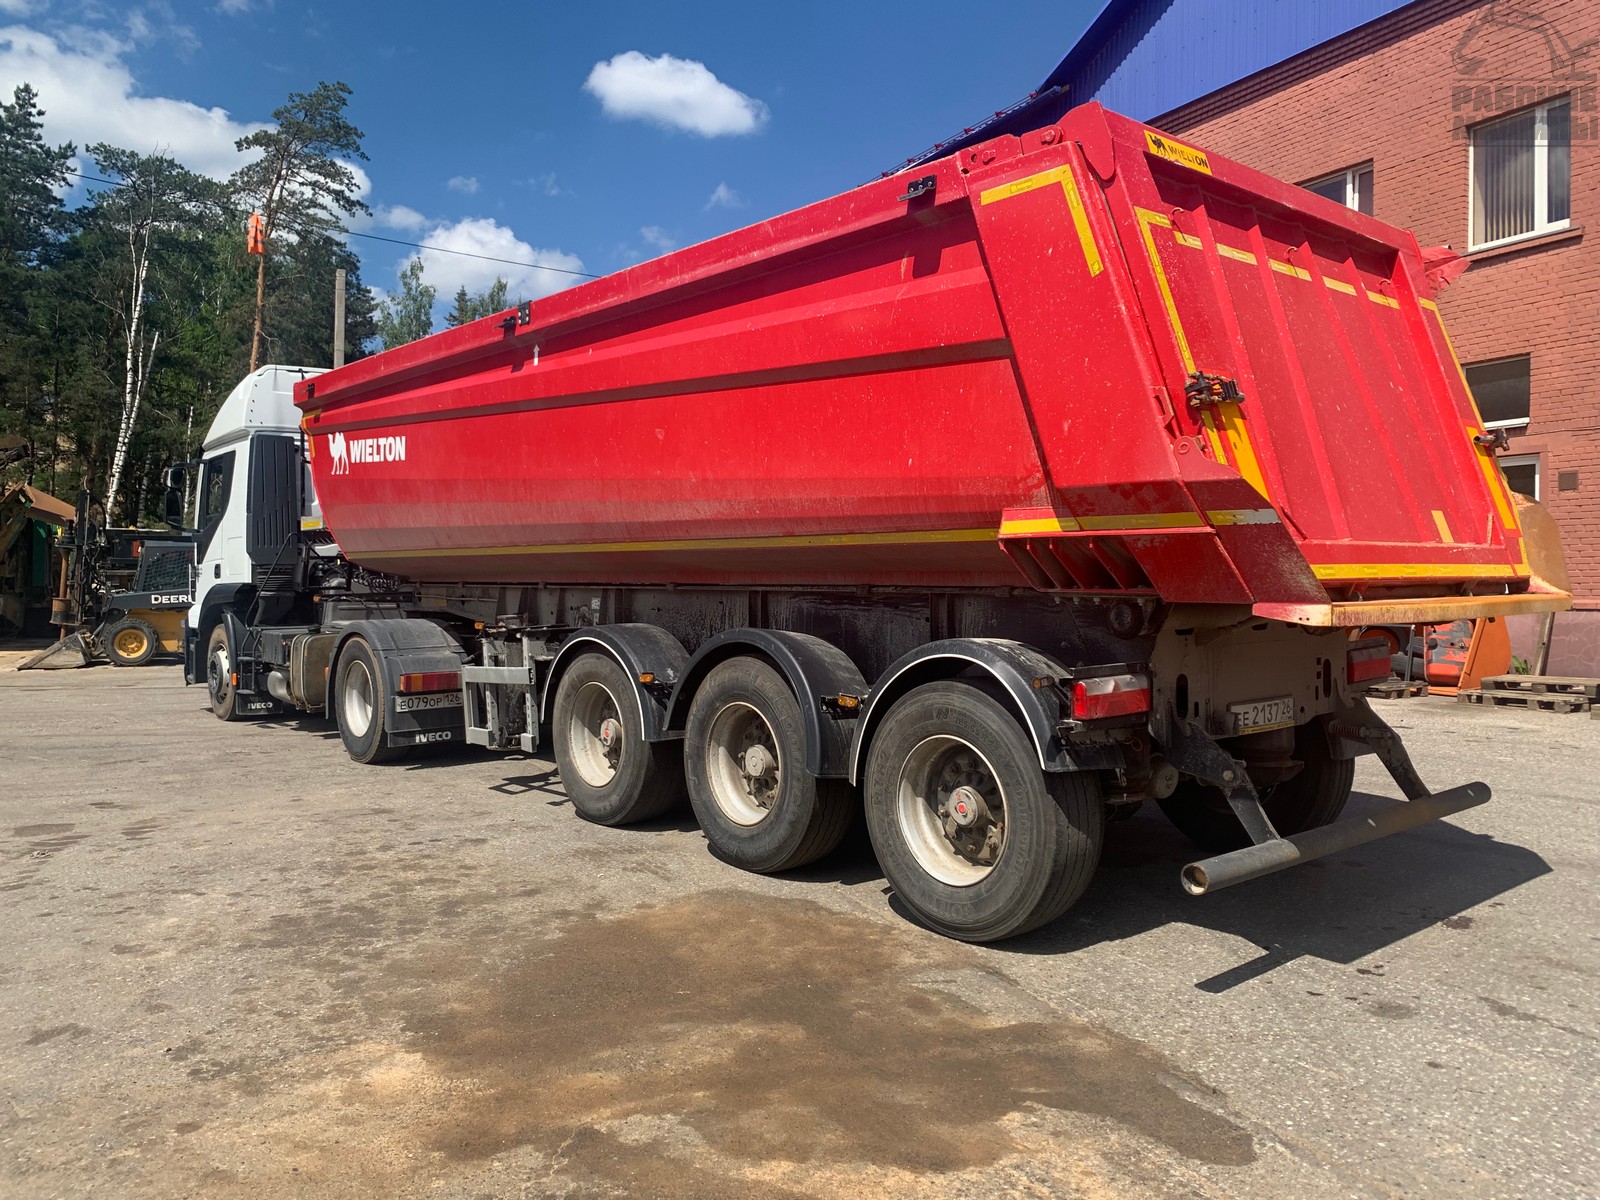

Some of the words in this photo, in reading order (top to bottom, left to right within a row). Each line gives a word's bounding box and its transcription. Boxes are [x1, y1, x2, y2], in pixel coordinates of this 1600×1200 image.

[1168, 144, 1209, 169] WIELTON
[349, 436, 406, 463] WIELTON
[151, 594, 191, 604] DEER
[444, 693, 460, 704] 126
[247, 701, 273, 710] IVECO
[415, 731, 452, 743] IVECO
